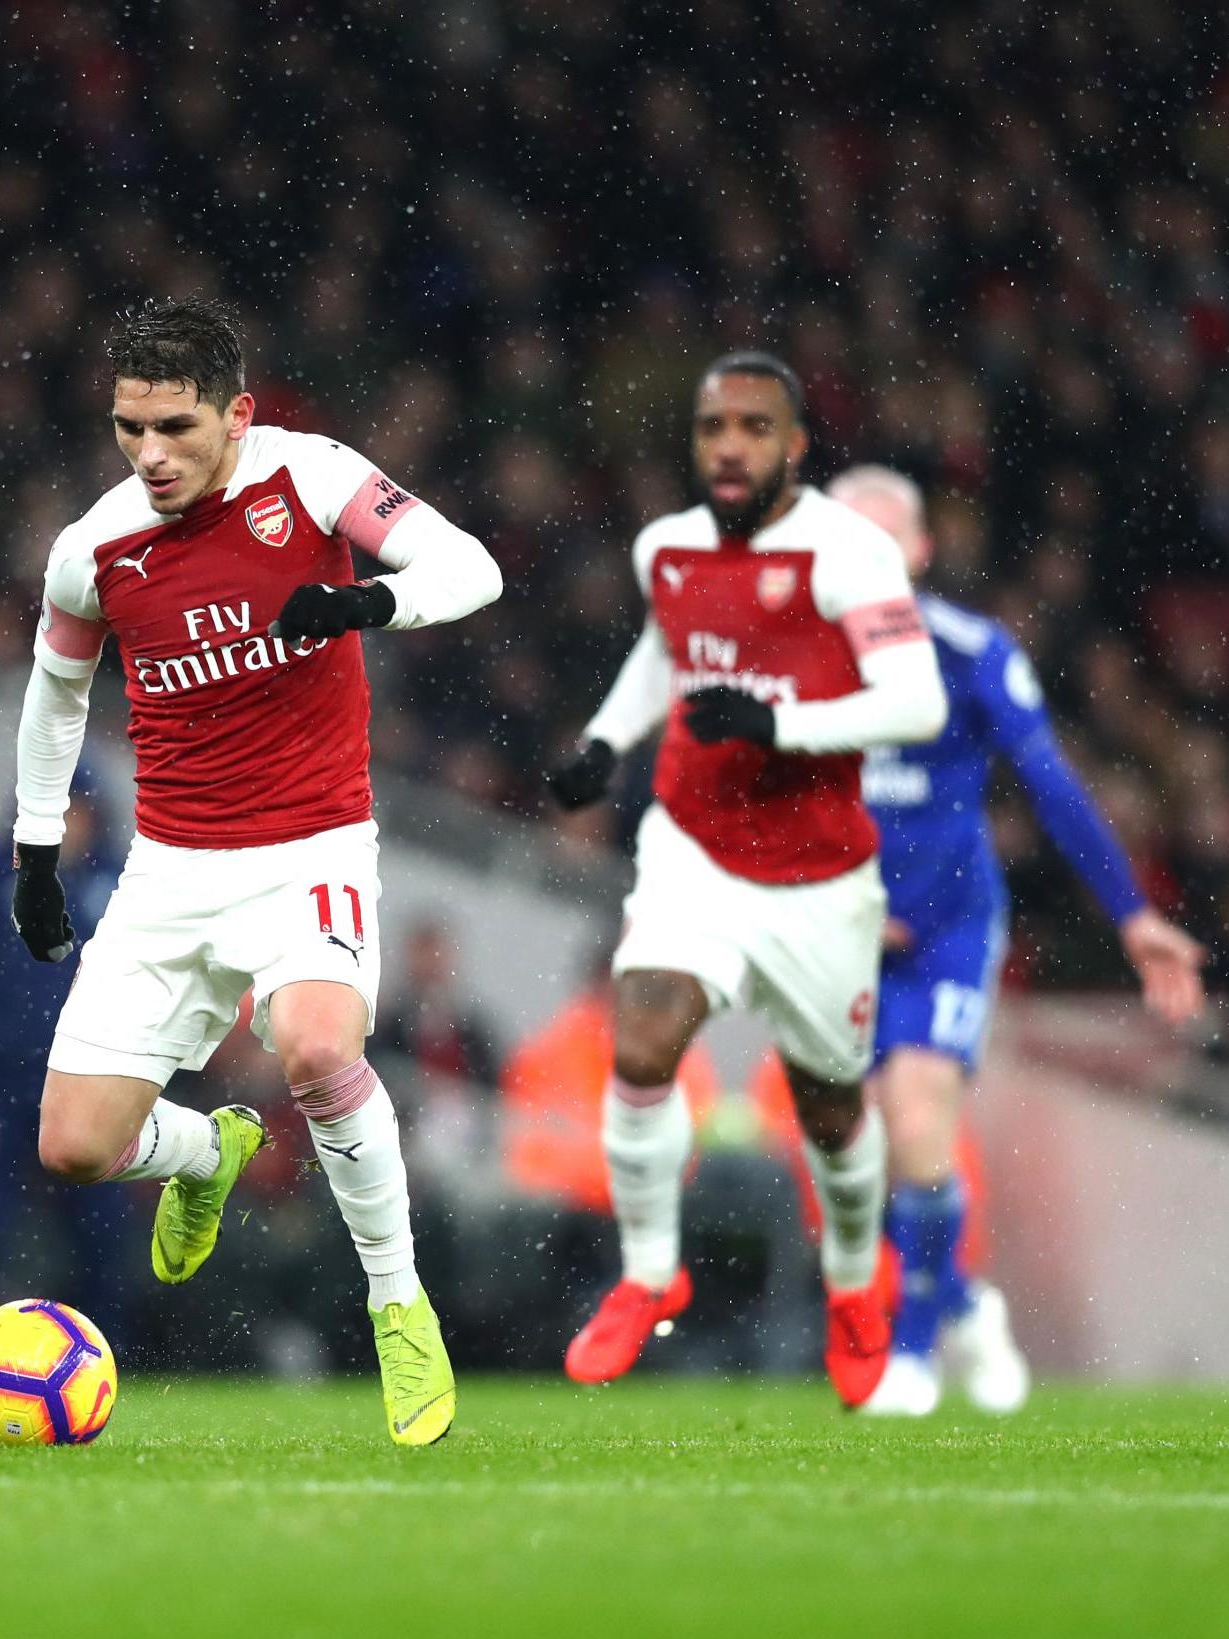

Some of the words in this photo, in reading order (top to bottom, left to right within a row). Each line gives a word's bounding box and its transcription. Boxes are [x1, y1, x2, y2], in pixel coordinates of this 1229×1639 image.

[251, 500, 285, 520] Arsenal
[182, 601, 251, 641] Fly
[308, 882, 364, 943] 11
